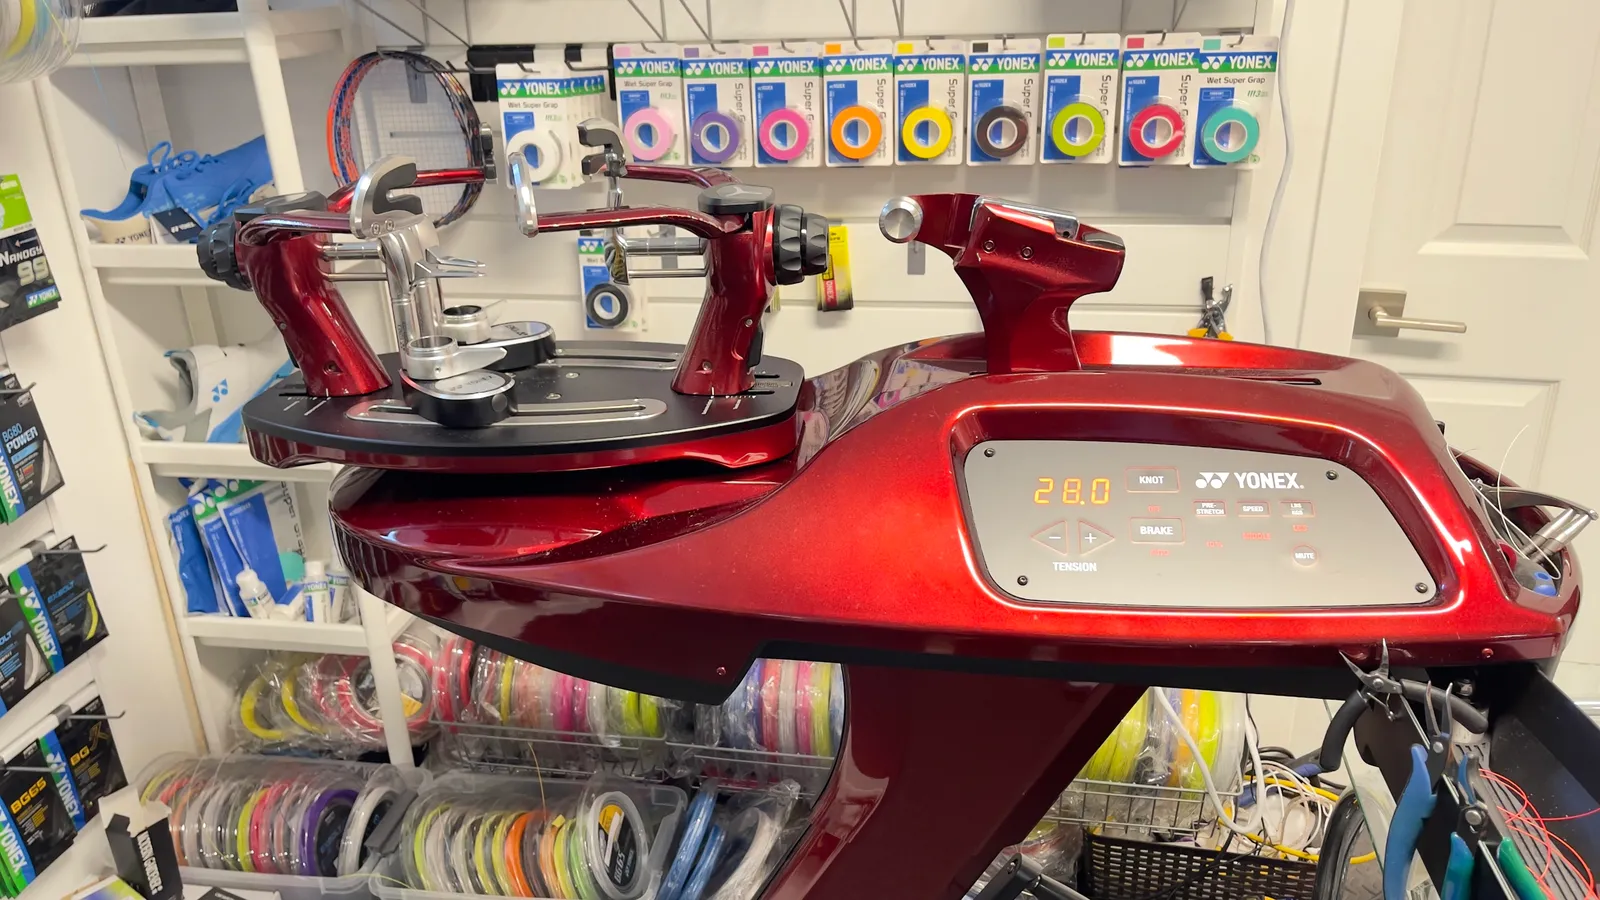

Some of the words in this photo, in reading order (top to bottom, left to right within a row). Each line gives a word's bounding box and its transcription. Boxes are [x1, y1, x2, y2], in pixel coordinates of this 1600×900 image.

[776, 60, 815, 73] YONEX
[849, 57, 888, 71] YONEX
[921, 57, 960, 71] YONEX
[996, 56, 1037, 71] YONEX
[1073, 52, 1116, 67] YONEX
[1152, 52, 1195, 67] YONEX
[1229, 55, 1273, 69] YONEX
[640, 61, 676, 74] YONEX
[708, 61, 744, 75] YONEX
[523, 81, 561, 95] YONEX
[638, 80, 657, 88] Super
[1247, 77, 1266, 85] Grap
[734, 82, 744, 111] Super
[803, 82, 814, 111] Super
[875, 79, 887, 108] Super
[946, 79, 958, 108] Super
[1021, 78, 1034, 108] Super
[1099, 75, 1112, 106] Super
[1178, 74, 1192, 106] Super
[523, 101, 542, 109] Super
[17, 255, 50, 286] 99
[38, 288, 58, 302] YONEX
[2, 422, 23, 443] BG80
[6, 426, 39, 454] POWER
[1139, 476, 1165, 484] KNOT
[1034, 478, 1111, 505] 28.0
[1140, 526, 1174, 535] BRAKE
[1052, 562, 1098, 572] TENSION
[31, 611, 58, 660] YONEX
[10, 777, 47, 814] BG65
[56, 776, 80, 818] YONEX
[0, 823, 28, 874] YONEX
[614, 851, 626, 884] BG65
